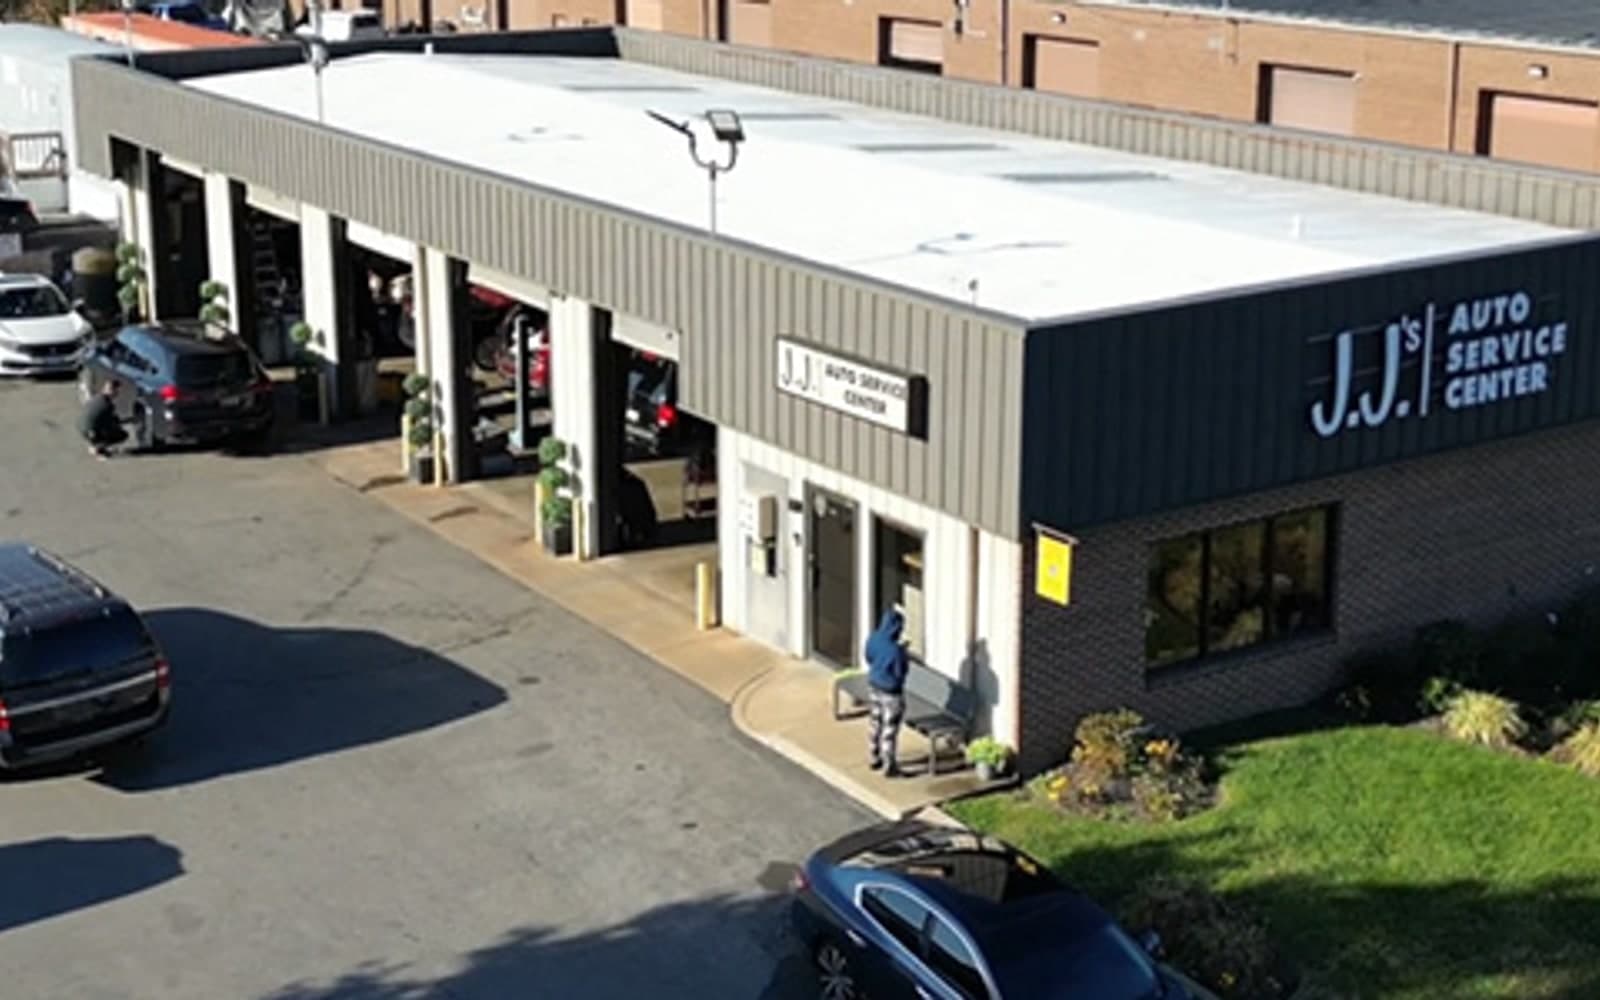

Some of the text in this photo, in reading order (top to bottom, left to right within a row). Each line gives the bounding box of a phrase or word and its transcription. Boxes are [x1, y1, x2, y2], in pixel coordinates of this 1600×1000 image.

[1449, 292, 1530, 334] AUTO
[1446, 323, 1567, 372] SERVICE
[843, 390, 887, 414] CENTER
[1445, 363, 1547, 409] CENTER
